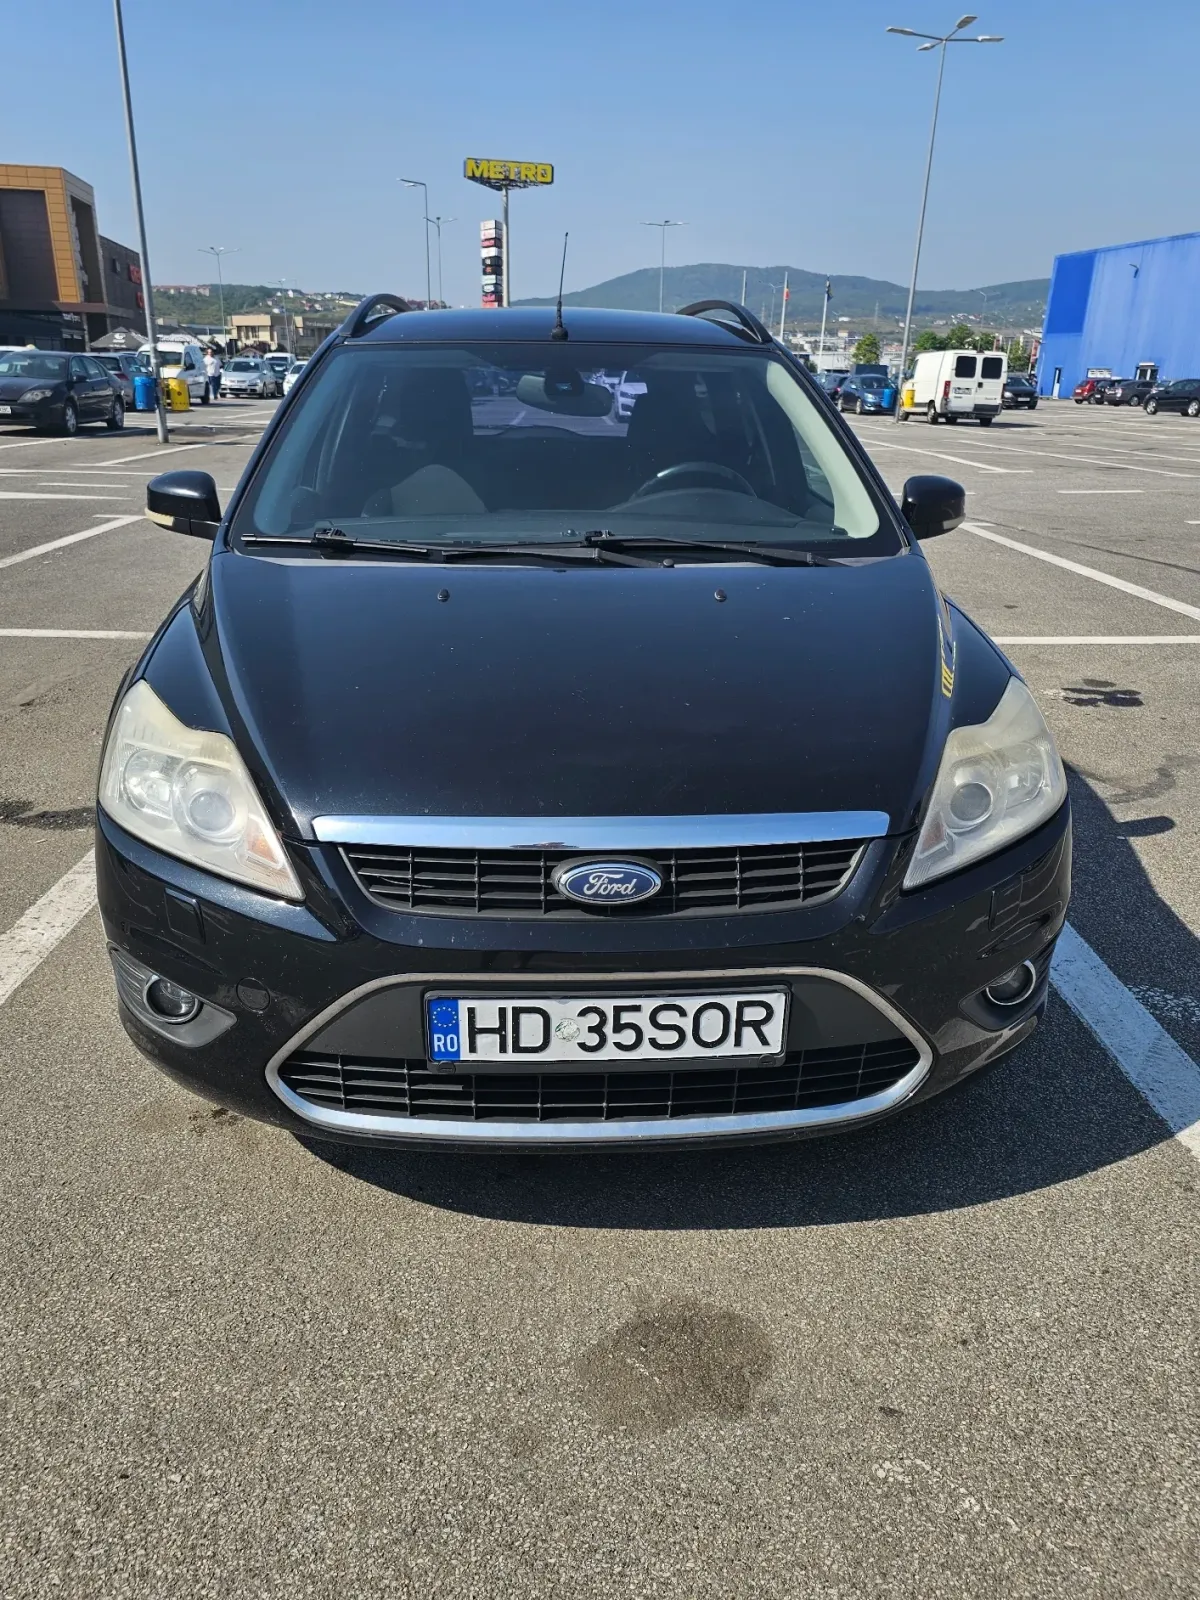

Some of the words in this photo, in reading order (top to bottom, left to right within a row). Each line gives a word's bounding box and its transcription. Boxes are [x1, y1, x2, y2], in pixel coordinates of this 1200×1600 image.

[466, 159, 552, 182] METRO
[583, 872, 637, 895] Ford
[467, 1006, 551, 1053] HD
[433, 1033, 458, 1052] RO
